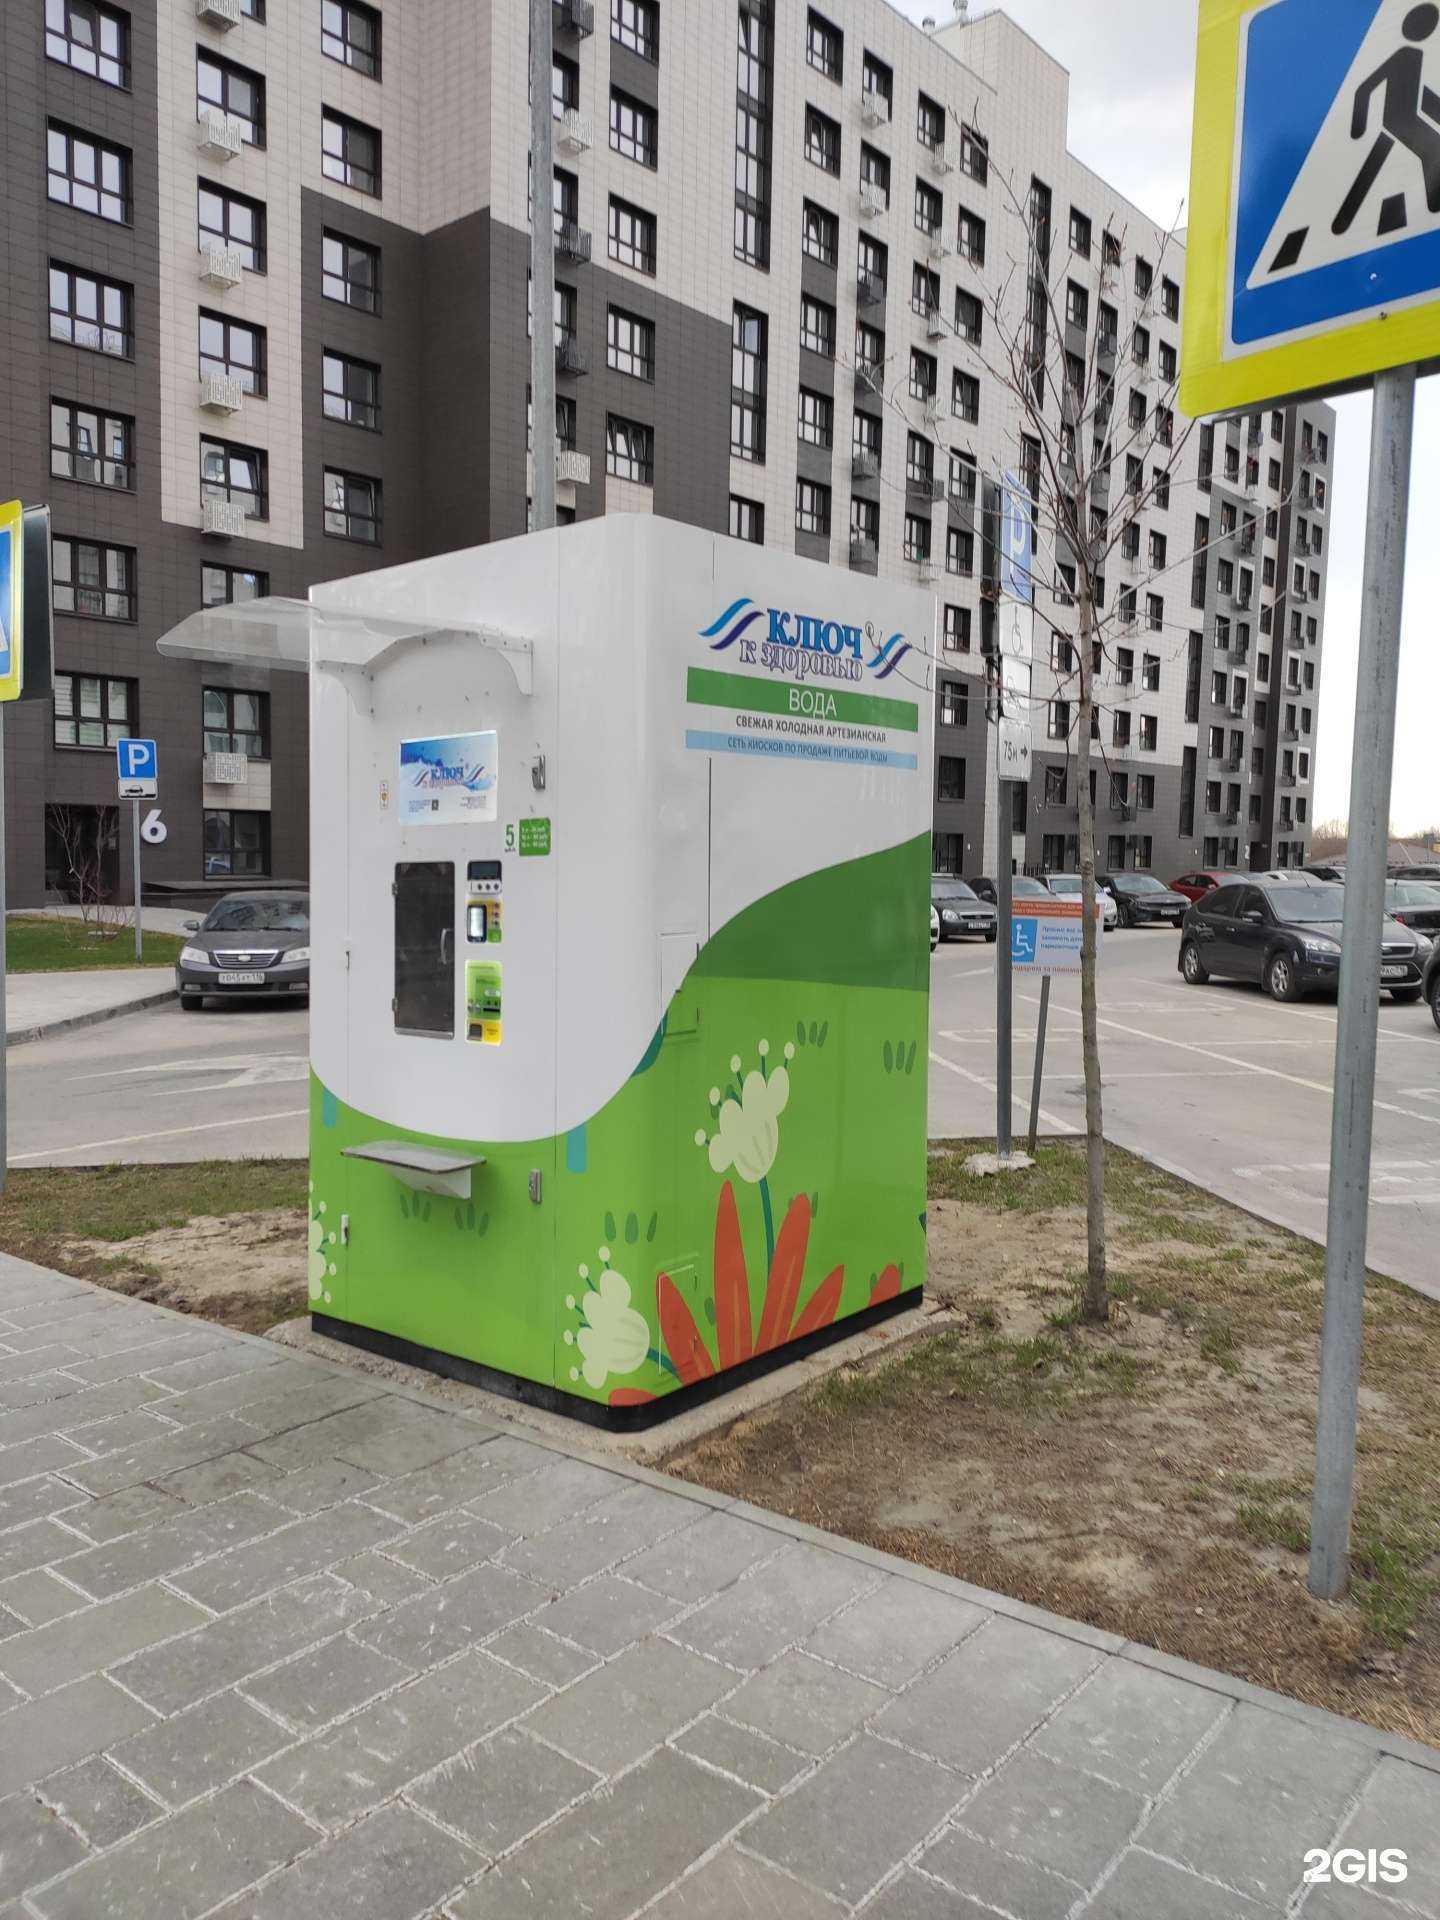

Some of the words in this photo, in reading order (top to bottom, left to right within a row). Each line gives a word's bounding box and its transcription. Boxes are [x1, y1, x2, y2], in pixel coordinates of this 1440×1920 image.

[767, 608, 863, 659] КЛЮЧ
[789, 688, 837, 720] ВОДА
[736, 715, 773, 731] СВЕЖАЯ
[776, 720, 824, 736] ХОЛОДНАЯ
[827, 726, 887, 743] АРТЕЗИАНСКАЯ
[128, 744, 150, 775] P
[728, 737, 746, 749] СЕТЬ
[748, 740, 783, 753] КИОСКОВ
[785, 743, 797, 754] ПО
[798, 743, 831, 757] ПРОДАЖЕ
[833, 747, 869, 761] ПИТЬЕВОЙ
[871, 750, 888, 762] ВОДЫ
[431, 766, 464, 781] КЛЮЧ
[141, 809, 168, 843] 6
[506, 824, 515, 847] 5
